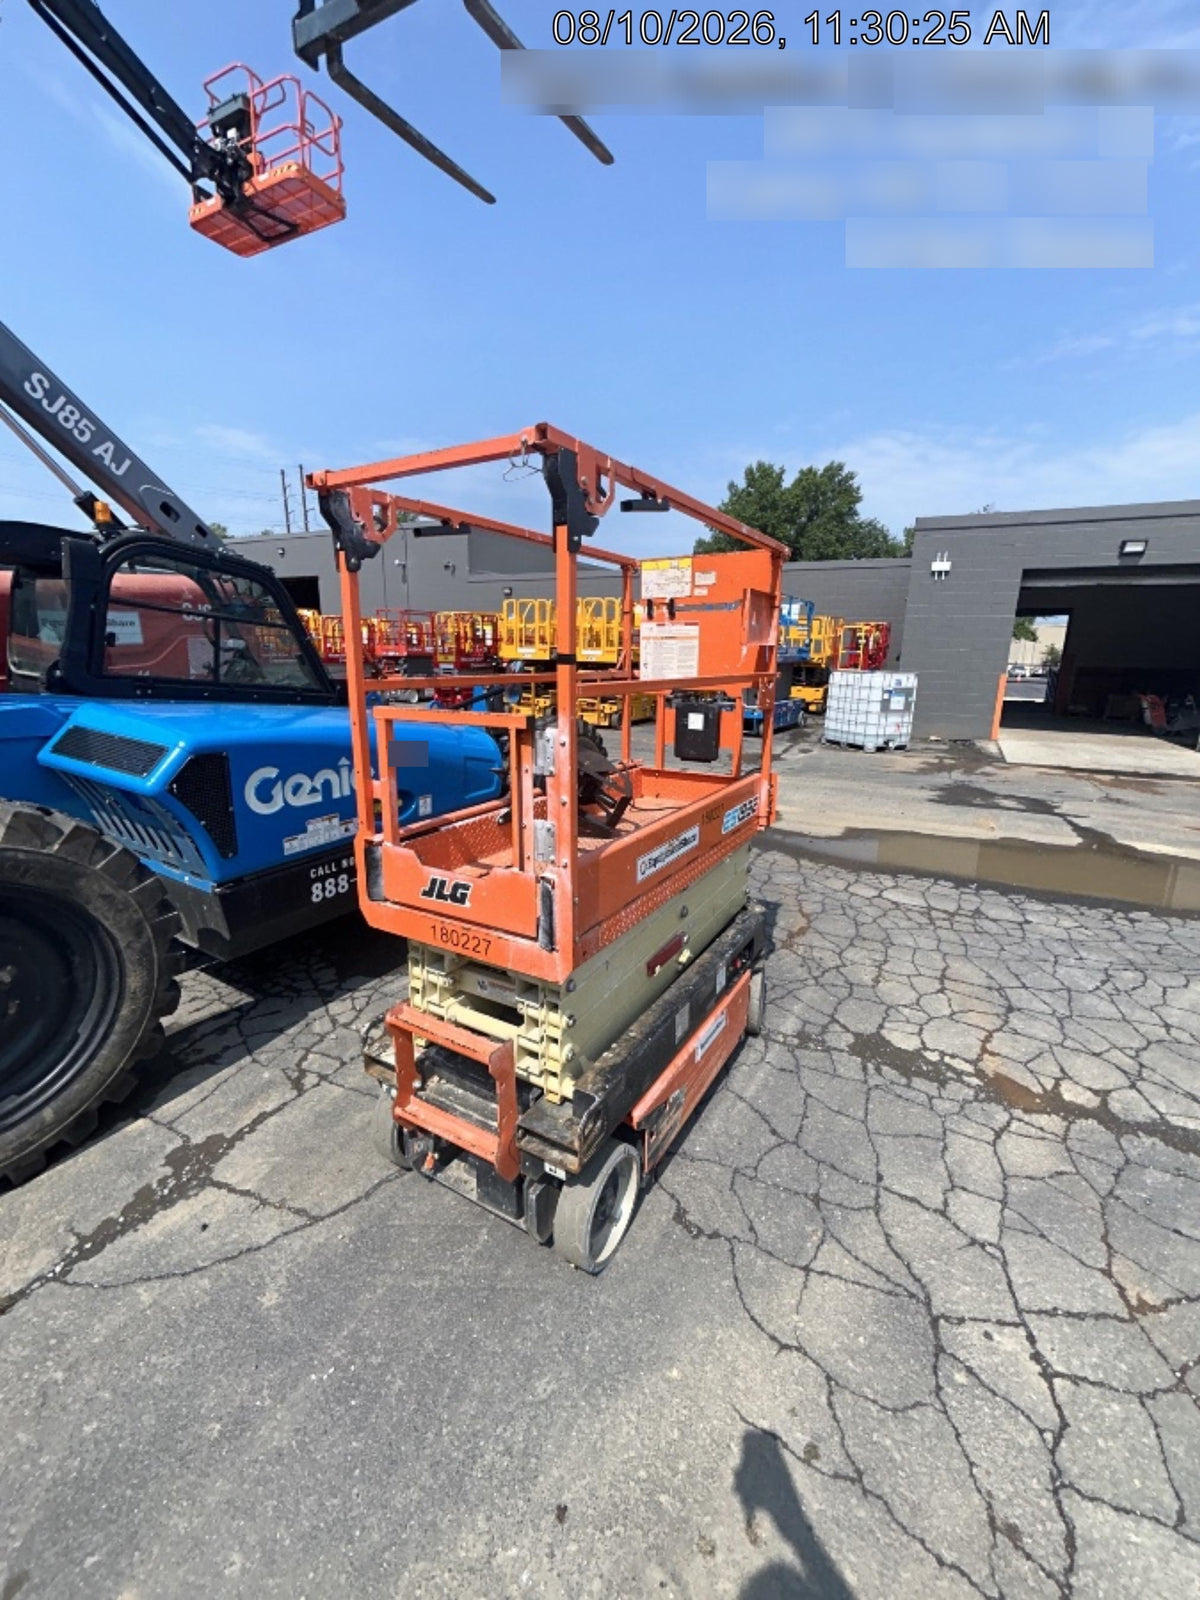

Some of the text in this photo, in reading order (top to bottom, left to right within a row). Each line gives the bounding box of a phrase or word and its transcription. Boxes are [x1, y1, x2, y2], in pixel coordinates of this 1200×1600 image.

[24, 372, 132, 475] SJ85 AJ
[244, 756, 366, 815] Geni
[310, 862, 337, 879] CALL
[421, 877, 471, 907] JLG
[431, 925, 492, 956] 180227
